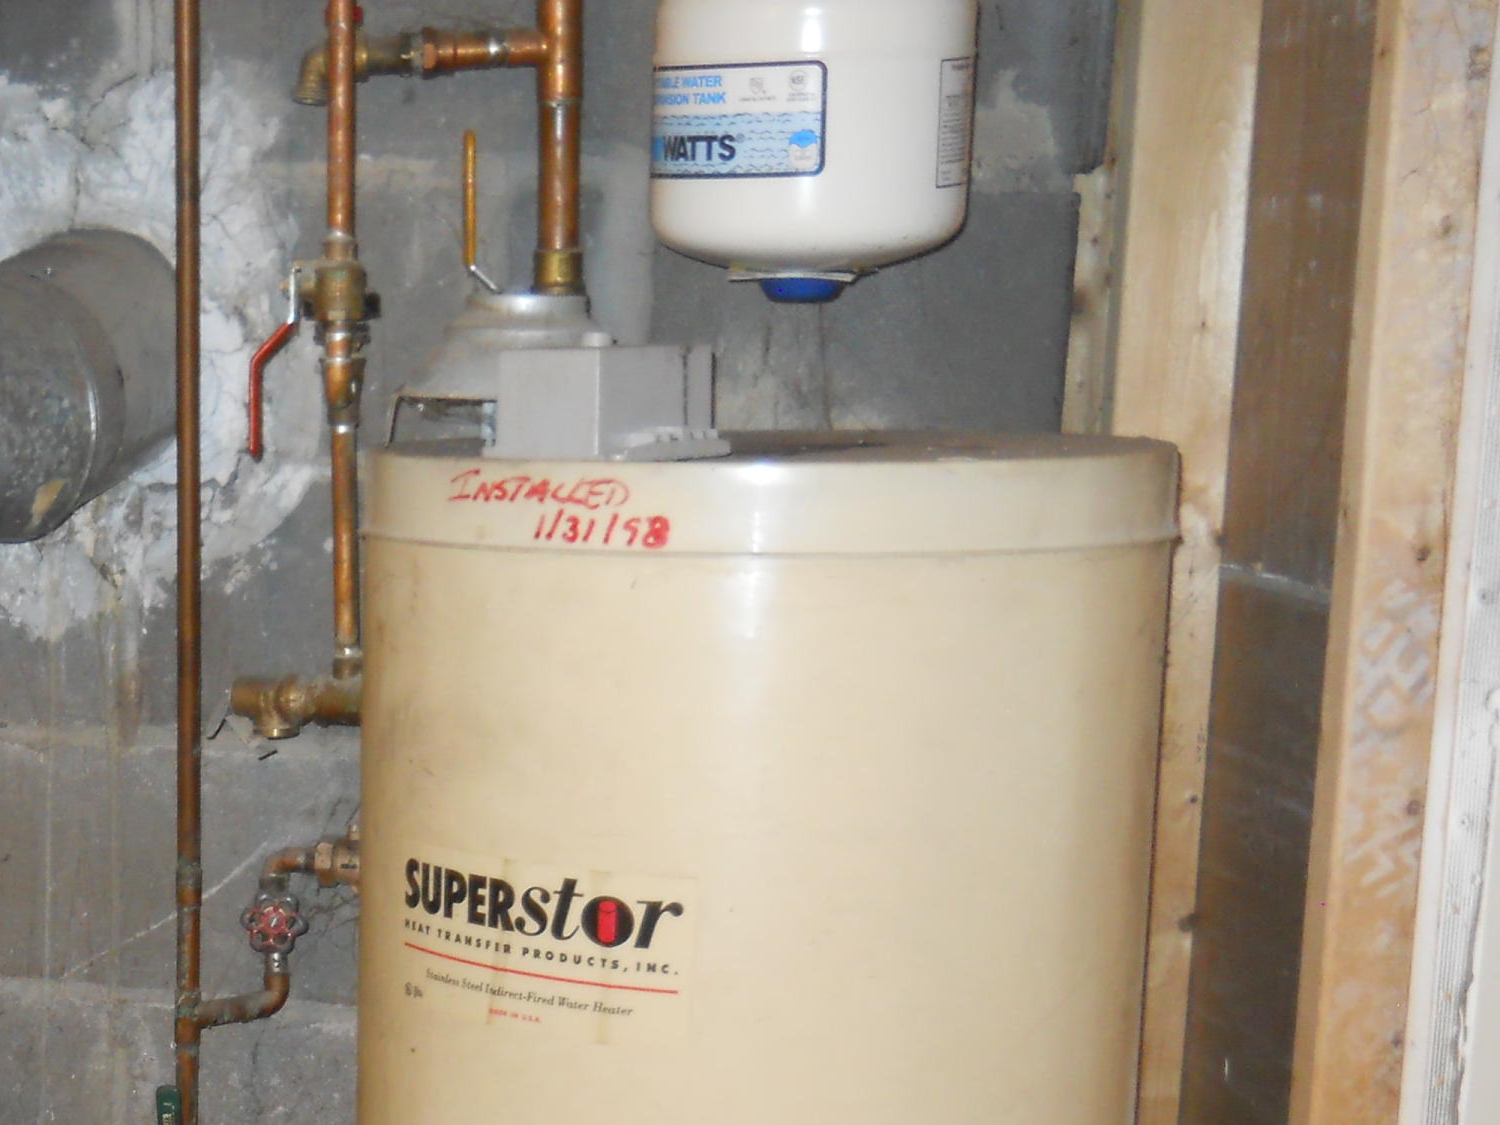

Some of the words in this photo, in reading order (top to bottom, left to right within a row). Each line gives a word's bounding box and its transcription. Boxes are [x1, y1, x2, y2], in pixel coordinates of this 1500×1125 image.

[682, 75, 722, 89] WATER
[693, 92, 726, 105] TANK
[663, 134, 736, 162] WATTS
[448, 469, 630, 509] INSTALLED
[533, 508, 670, 548] 1/31/98
[404, 919, 430, 936] HEAT
[437, 927, 512, 955] TRANSFER
[522, 946, 628, 973] PRODUCTS,
[636, 962, 679, 976] INC.
[426, 967, 460, 988] Stainless
[461, 978, 483, 994] Steel
[485, 983, 555, 1007] Indirect-Fired
[557, 995, 589, 1011] Water
[592, 1003, 634, 1017] Heater
